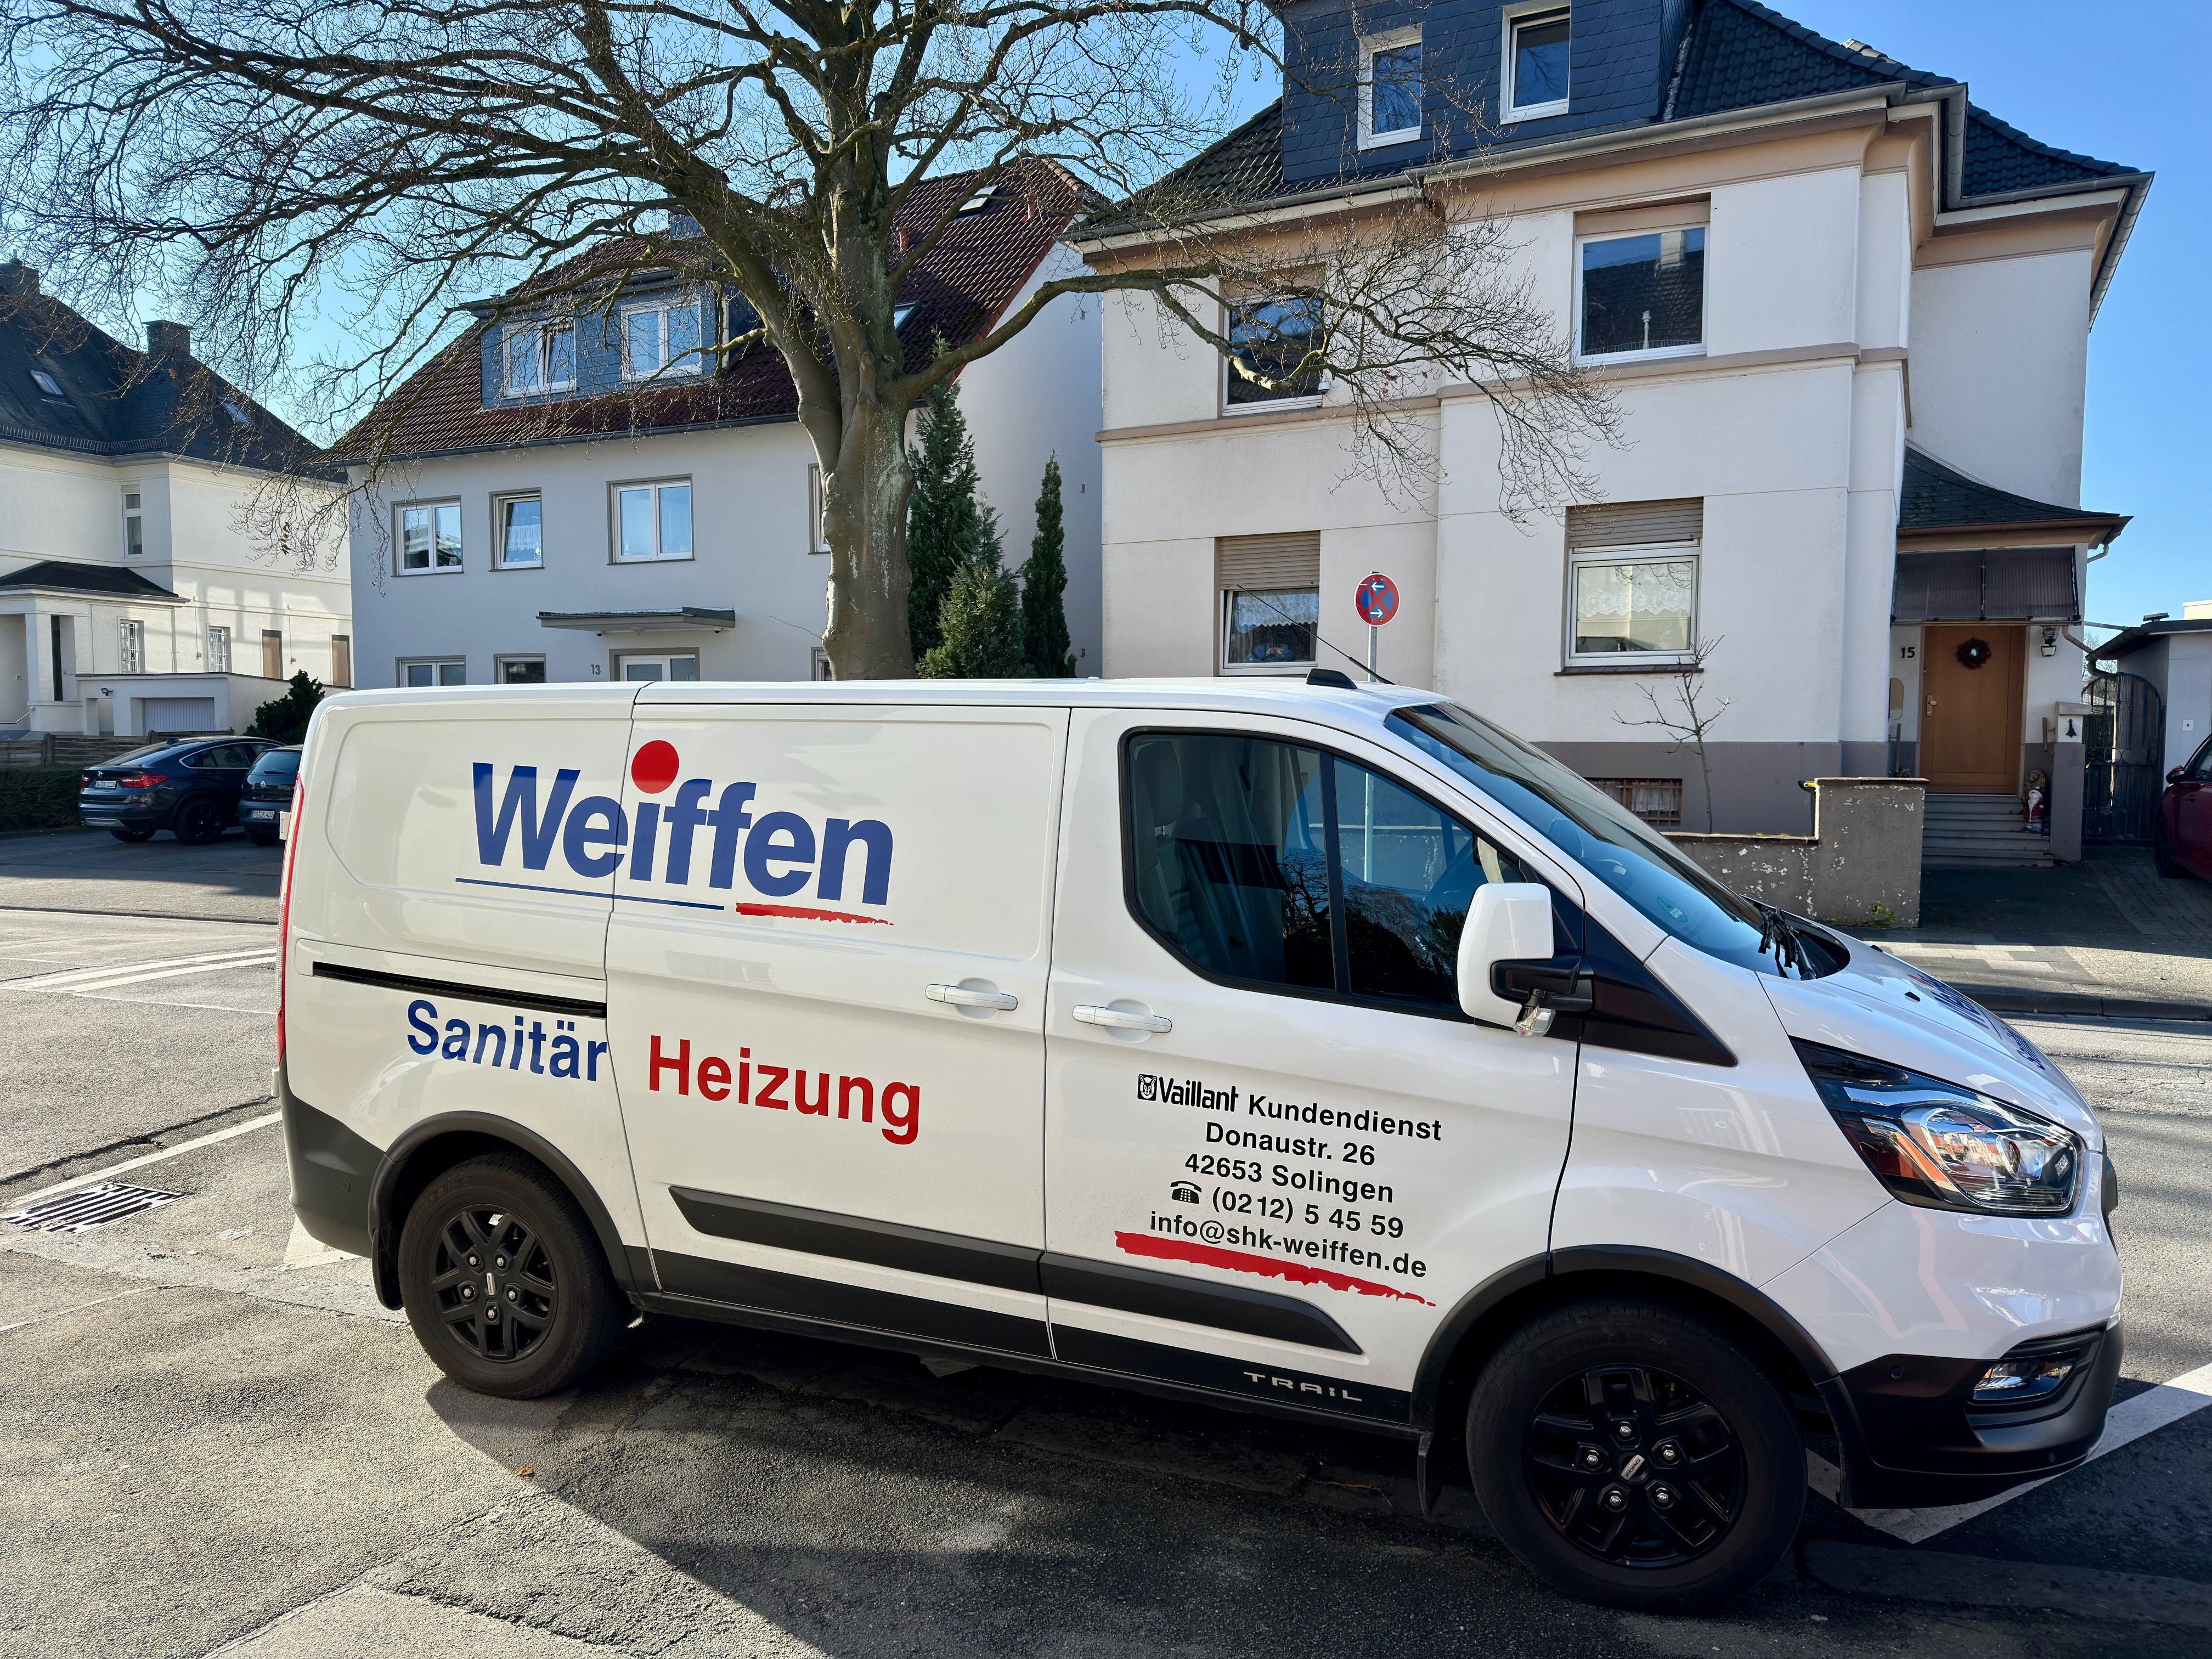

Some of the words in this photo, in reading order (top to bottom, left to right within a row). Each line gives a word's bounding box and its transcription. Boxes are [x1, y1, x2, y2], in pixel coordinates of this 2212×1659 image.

[591, 664, 601, 675] 13
[1901, 647, 1915, 658] 15
[472, 740, 893, 906] Weiffen
[407, 1000, 607, 1081] Sanitär
[649, 1035, 921, 1144] Heizung
[1159, 1076, 1239, 1112] Vaillant
[1249, 1094, 1442, 1141] Kundendienst
[1206, 1121, 1332, 1160] Donaustr.
[1342, 1142, 1375, 1166] 26
[1185, 1153, 1262, 1182] 42653
[1272, 1164, 1393, 1203] Solingen
[1212, 1187, 1294, 1224] (0212)
[1304, 1204, 1319, 1224] 5
[1329, 1209, 1361, 1232] 45
[1370, 1214, 1403, 1238] 59
[1150, 1210, 1426, 1278] info@shk-weiffen.de
[1243, 1372, 1362, 1402] TRAIL
[1626, 1459, 1641, 1477] FORD
